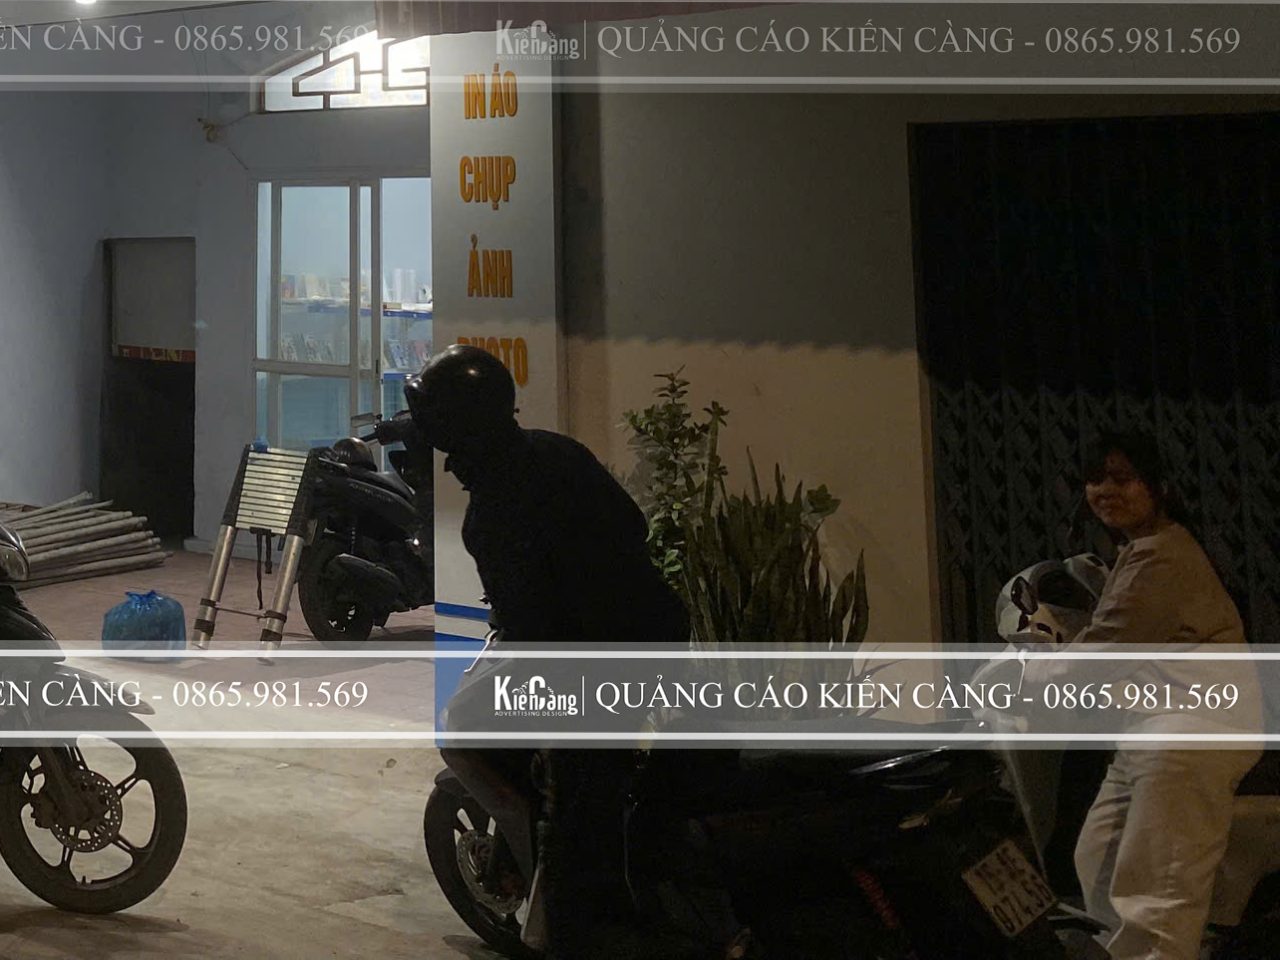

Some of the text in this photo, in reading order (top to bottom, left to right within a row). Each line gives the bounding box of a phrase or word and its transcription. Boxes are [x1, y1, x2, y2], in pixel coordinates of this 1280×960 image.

[464, 62, 519, 119] IN ÁO
[459, 155, 516, 211] CHỤP
[466, 234, 514, 299] ẢNH
